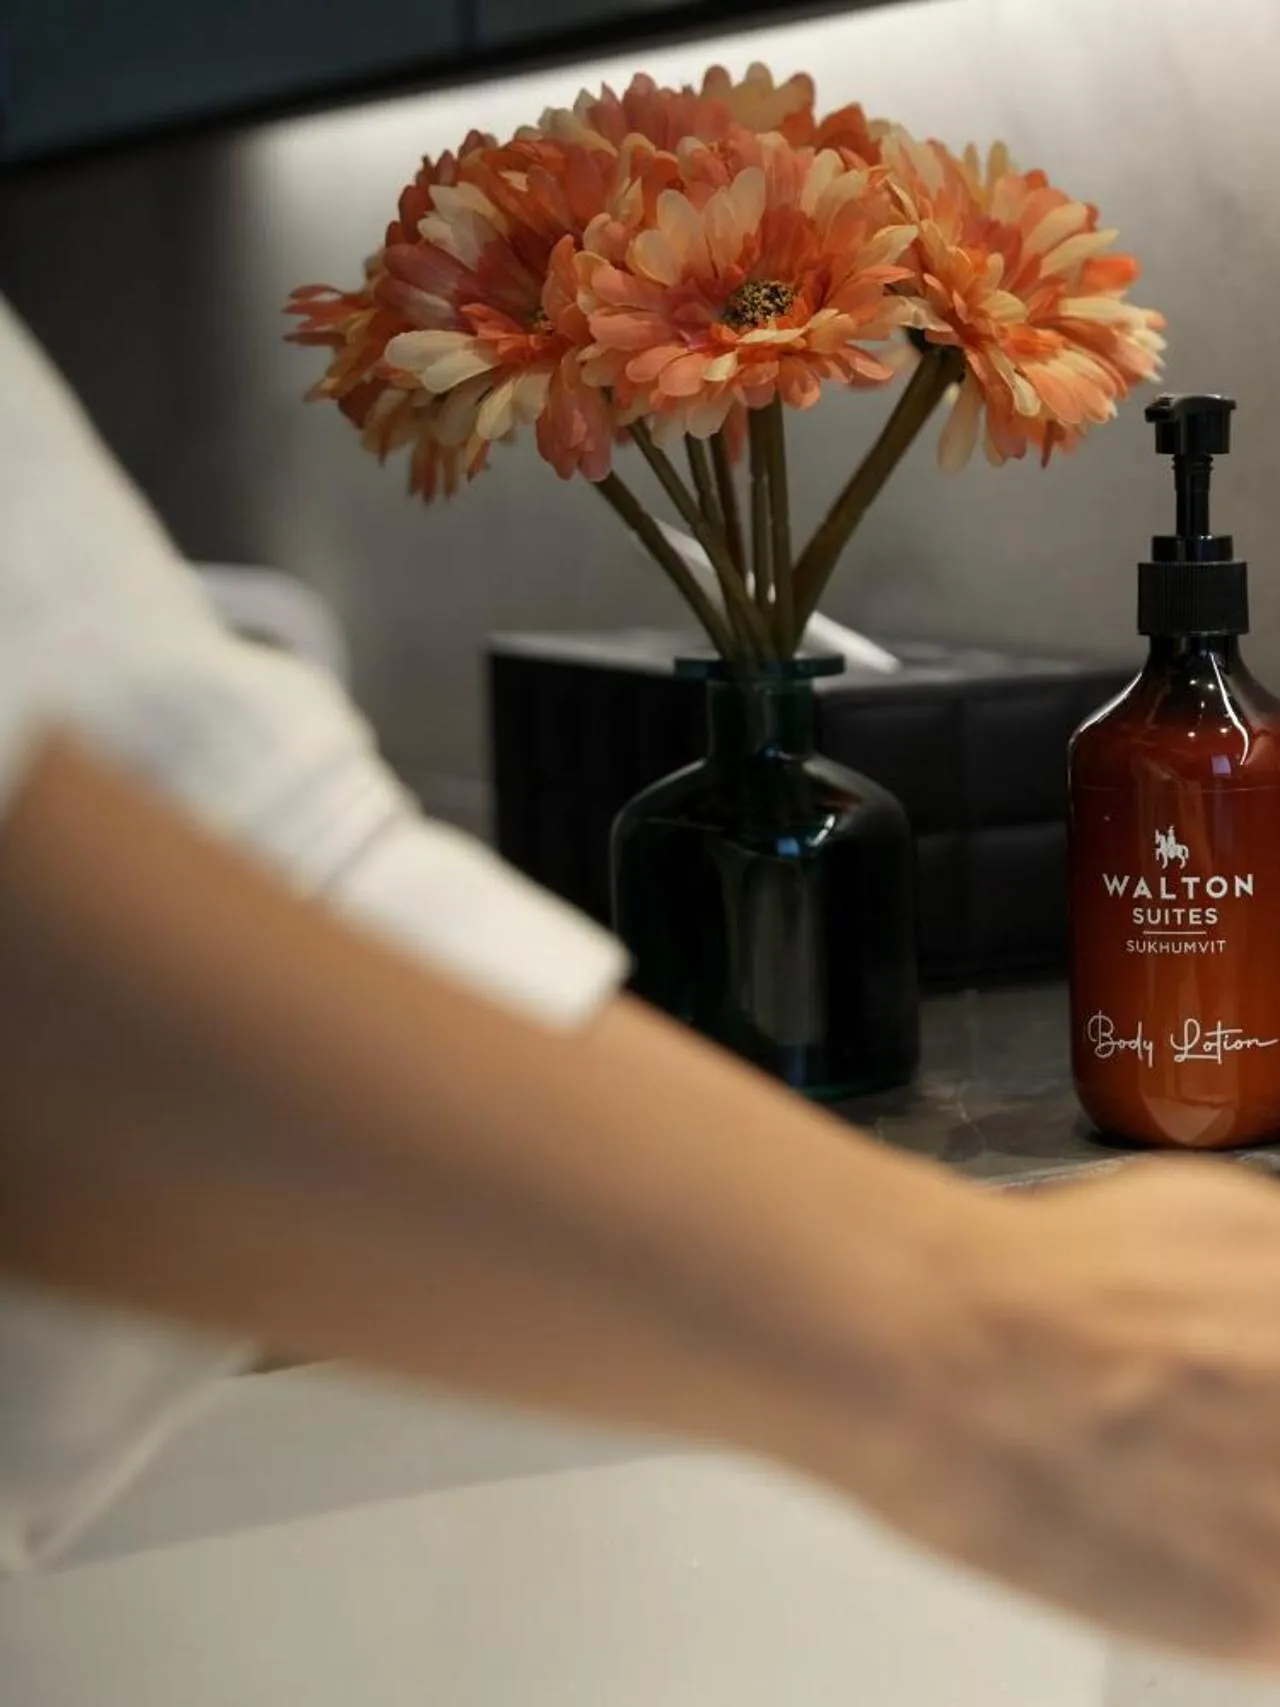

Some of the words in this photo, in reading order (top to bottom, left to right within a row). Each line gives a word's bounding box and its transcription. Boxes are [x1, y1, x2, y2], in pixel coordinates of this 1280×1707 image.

[1103, 873, 1254, 899] WALTON
[1132, 907, 1219, 925] SUITES
[1126, 939, 1227, 954] SUKHUMVIT
[1087, 1009, 1154, 1068] Body
[1170, 1018, 1280, 1065] Lotion
